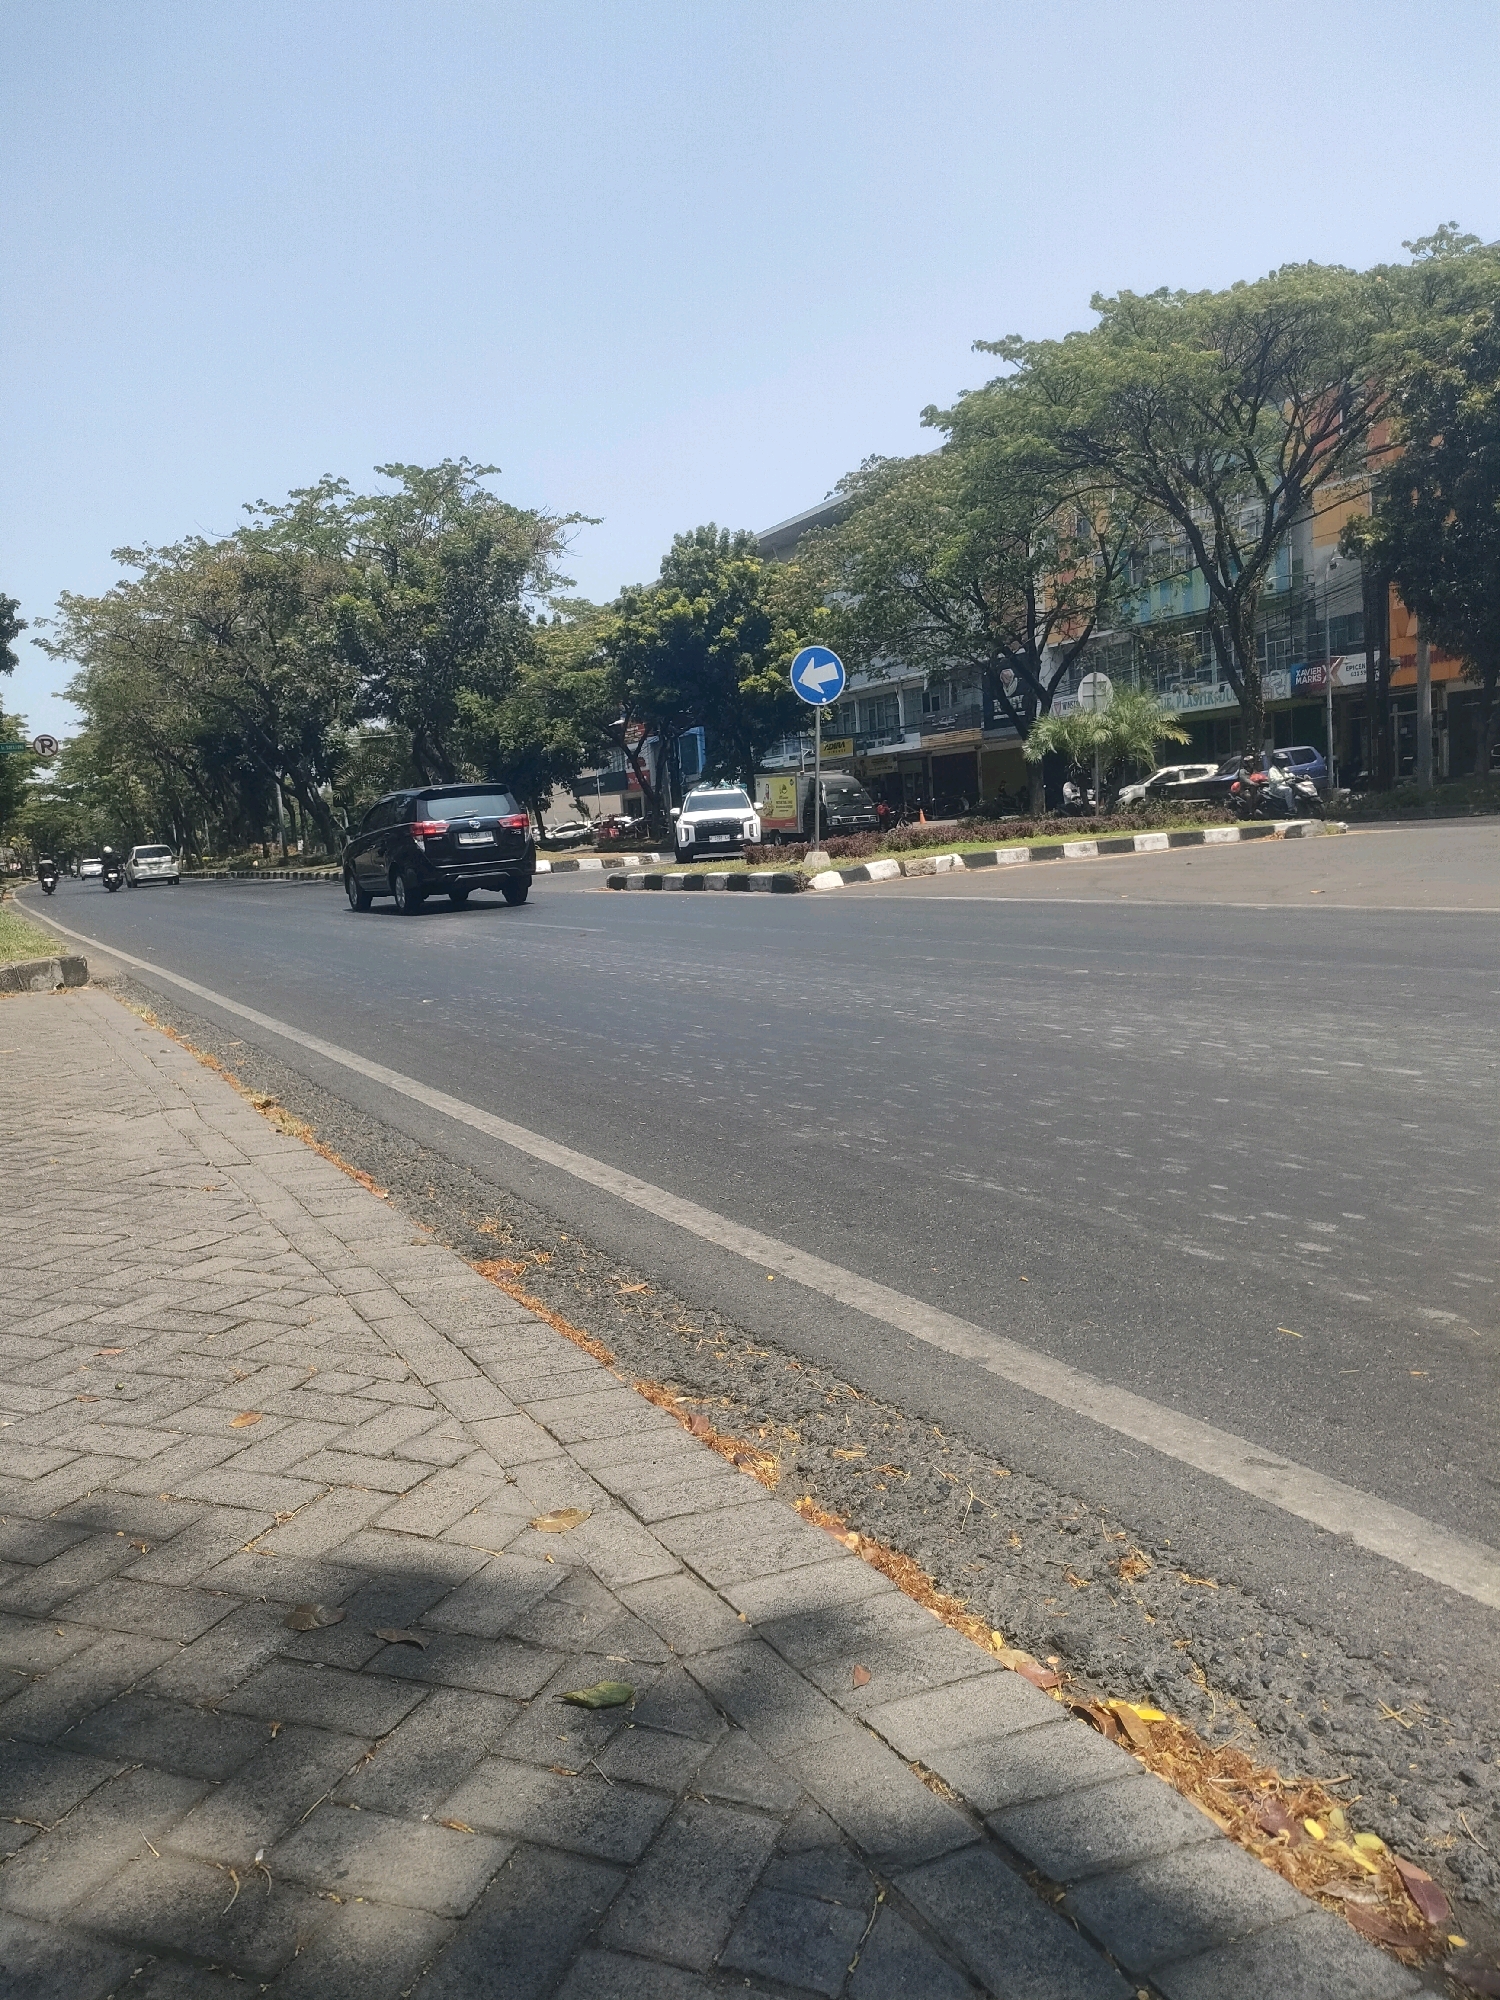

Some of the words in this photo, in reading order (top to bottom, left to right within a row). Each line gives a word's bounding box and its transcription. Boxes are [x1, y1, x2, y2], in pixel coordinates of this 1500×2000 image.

[1296, 666, 1322, 678] XAVIER
[1345, 663, 1366, 672] EPICEN
[1295, 674, 1322, 685] MARKS
